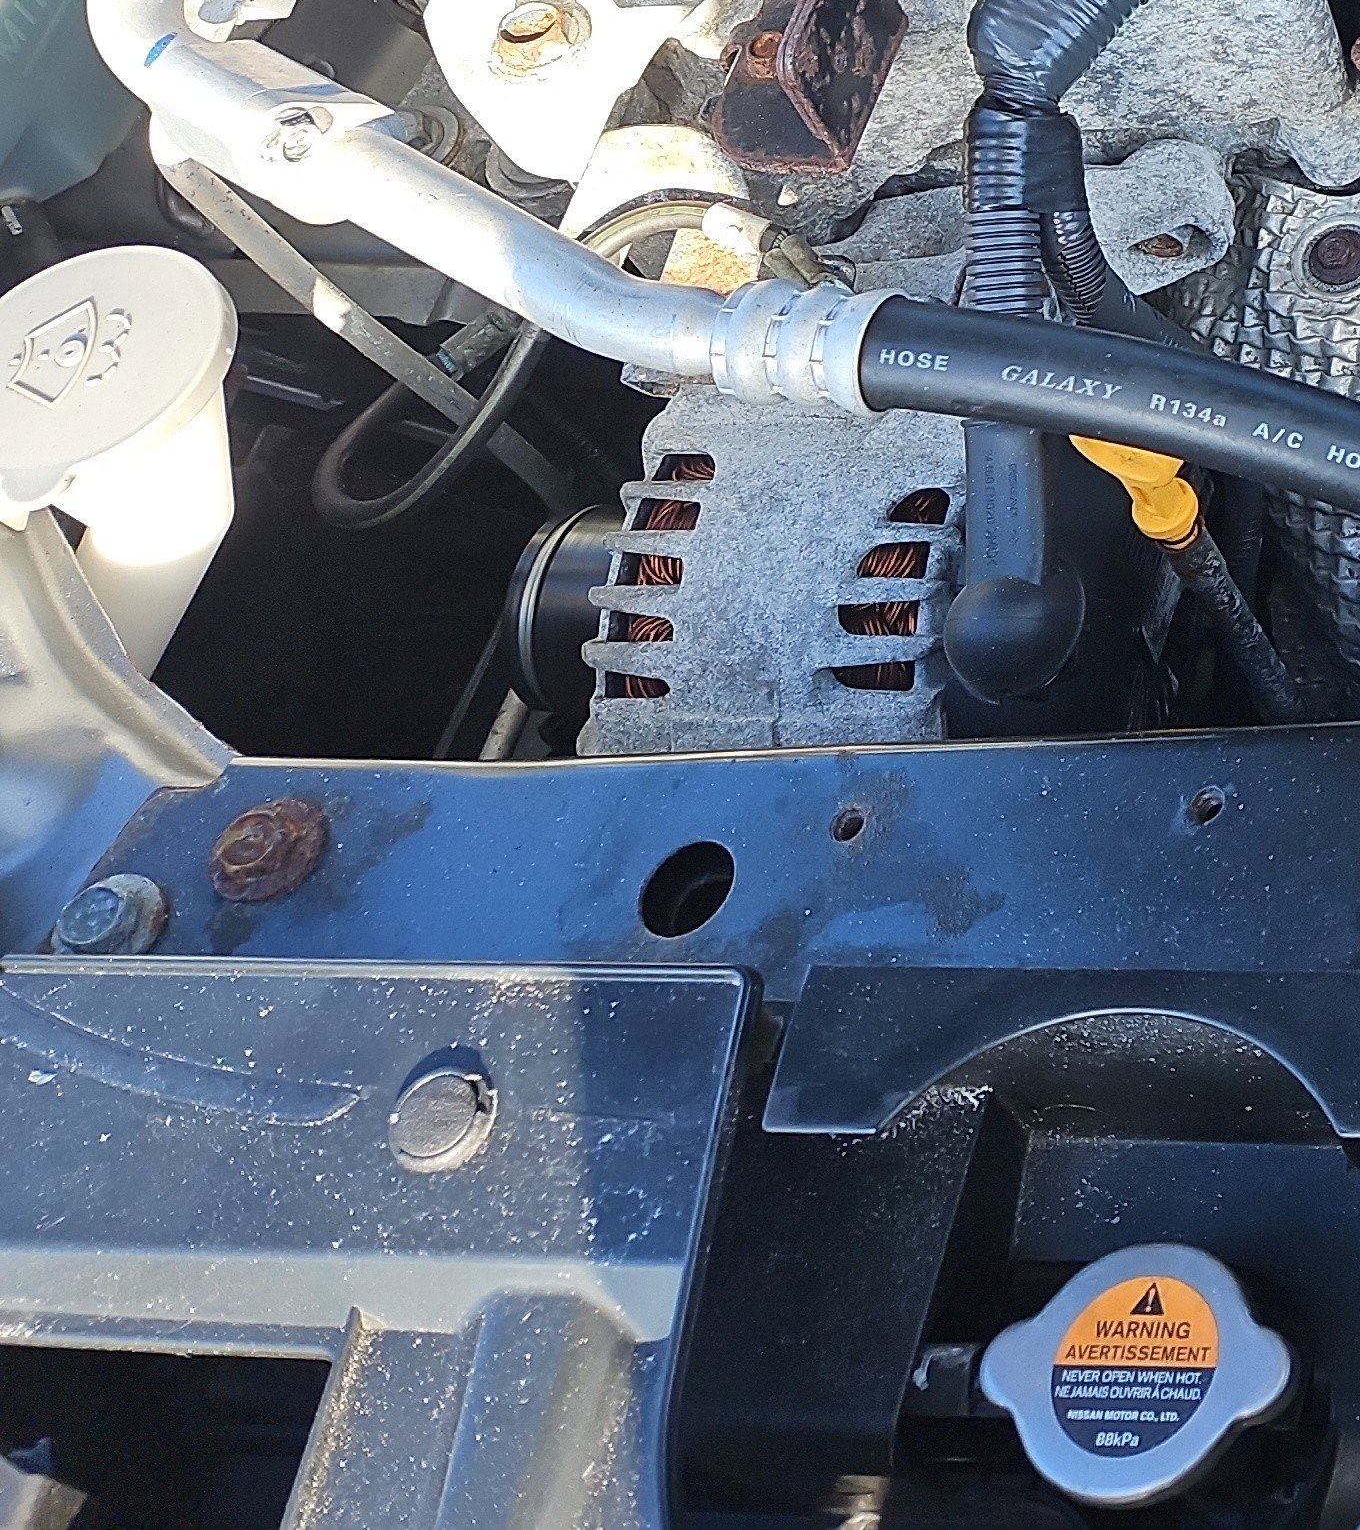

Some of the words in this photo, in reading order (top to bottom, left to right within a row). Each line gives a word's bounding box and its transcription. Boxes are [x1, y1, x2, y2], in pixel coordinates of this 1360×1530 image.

[878, 348, 950, 372] HOSE
[1001, 364, 1124, 400] GALAXY
[1149, 392, 1229, 428] R134a
[1252, 421, 1305, 450] A/C
[1095, 1320, 1192, 1340] WARNING
[1065, 1344, 1212, 1362] AVERTISSEMENT
[1061, 1369, 1101, 1383] NEVER
[1101, 1371, 1135, 1384] OPEN
[1137, 1371, 1176, 1384] WHEN
[1176, 1372, 1203, 1385] HOT.
[1054, 1385, 1070, 1398] NE
[1069, 1385, 1109, 1399] JAMAIS
[1109, 1386, 1150, 1399] OUVRIR
[1160, 1387, 1202, 1400] CHAUD.
[1067, 1408, 1103, 1421] NISSAN
[1104, 1409, 1139, 1421] MOTOR
[1160, 1411, 1181, 1423] LTD.
[1095, 1431, 1140, 1448] 88kPa
